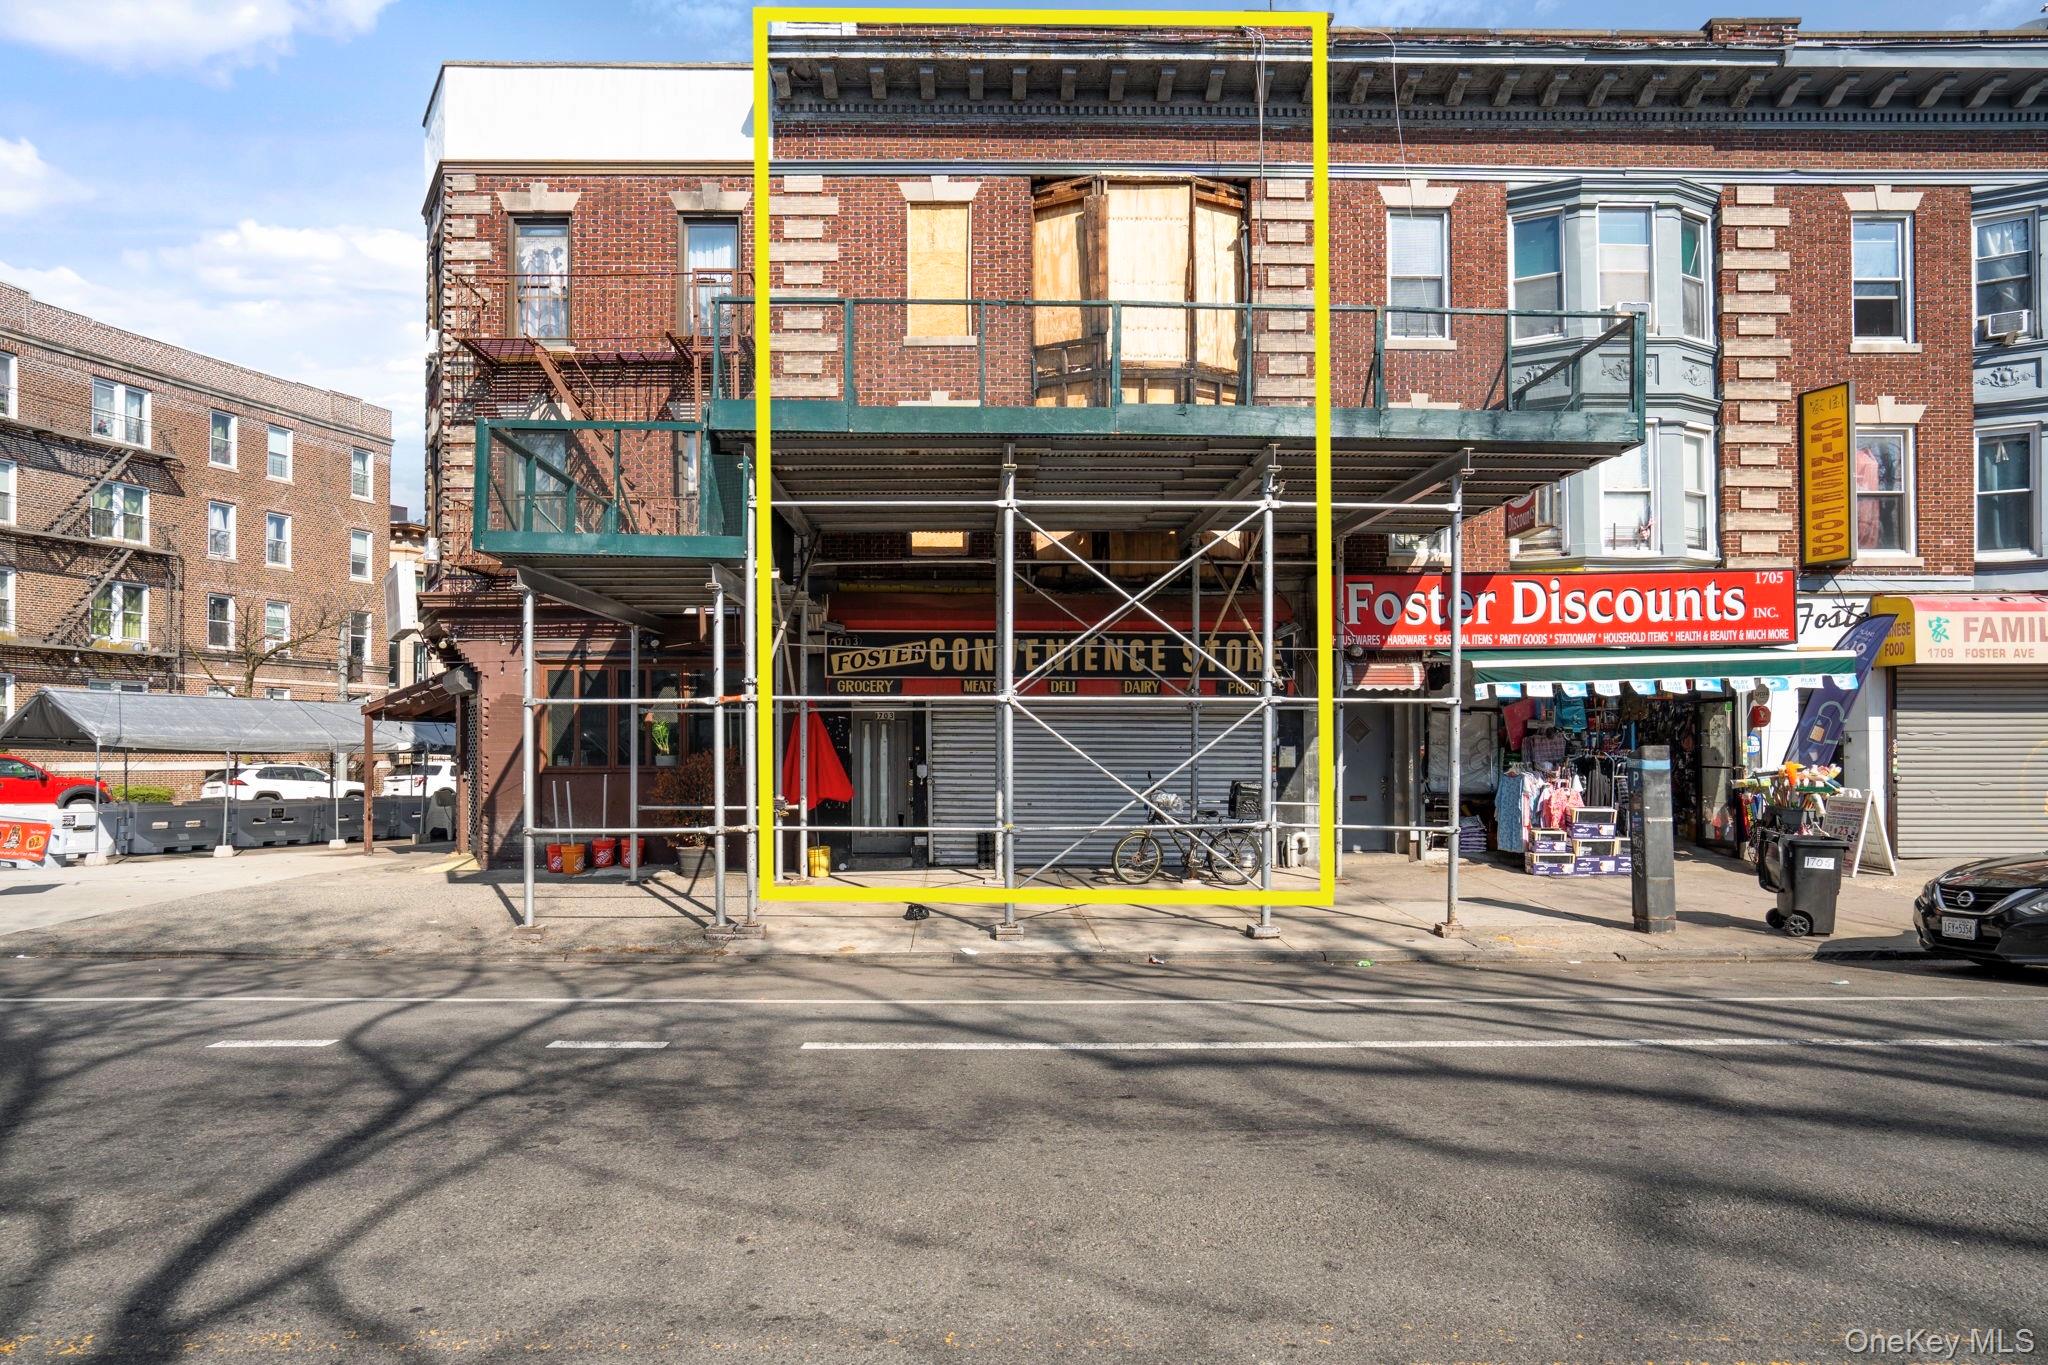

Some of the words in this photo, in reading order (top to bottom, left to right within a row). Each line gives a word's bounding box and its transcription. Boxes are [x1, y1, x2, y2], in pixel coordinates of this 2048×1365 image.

[1812, 505, 1845, 557] FOOD
[1755, 572, 1784, 584] 1705
[1346, 580, 1497, 626] Foster
[1511, 577, 1746, 626] Discounts
[1753, 607, 1779, 618] INC.
[1387, 634, 1427, 645] HARDWARE
[1434, 634, 1470, 645] SEASAL
[1472, 634, 1493, 645] ITEMS
[1500, 633, 1521, 645] PARTY
[1523, 633, 1547, 645] GOODS
[1554, 632, 1597, 644] STATIONARY
[1603, 632, 1646, 643] HOUSEHOLD
[1648, 631, 1669, 642] ITEMS
[1675, 630, 1702, 642] HEALTH
[1710, 629, 1738, 641] BEAUTY
[1746, 629, 1767, 640] MUCH
[1768, 628, 1789, 640] MORE
[837, 644, 924, 672] FOSTER
[929, 637, 1166, 671] CONENIENCE
[1884, 641, 1905, 657] FOOD
[1928, 648, 1954, 658] 1709
[1965, 648, 2006, 658] FOSTER
[2013, 648, 2035, 658] AVE
[837, 680, 893, 693] GROCERY
[1050, 681, 1076, 693] DELI
[1124, 681, 1160, 694] DAIRY
[875, 712, 894, 720] 1703
